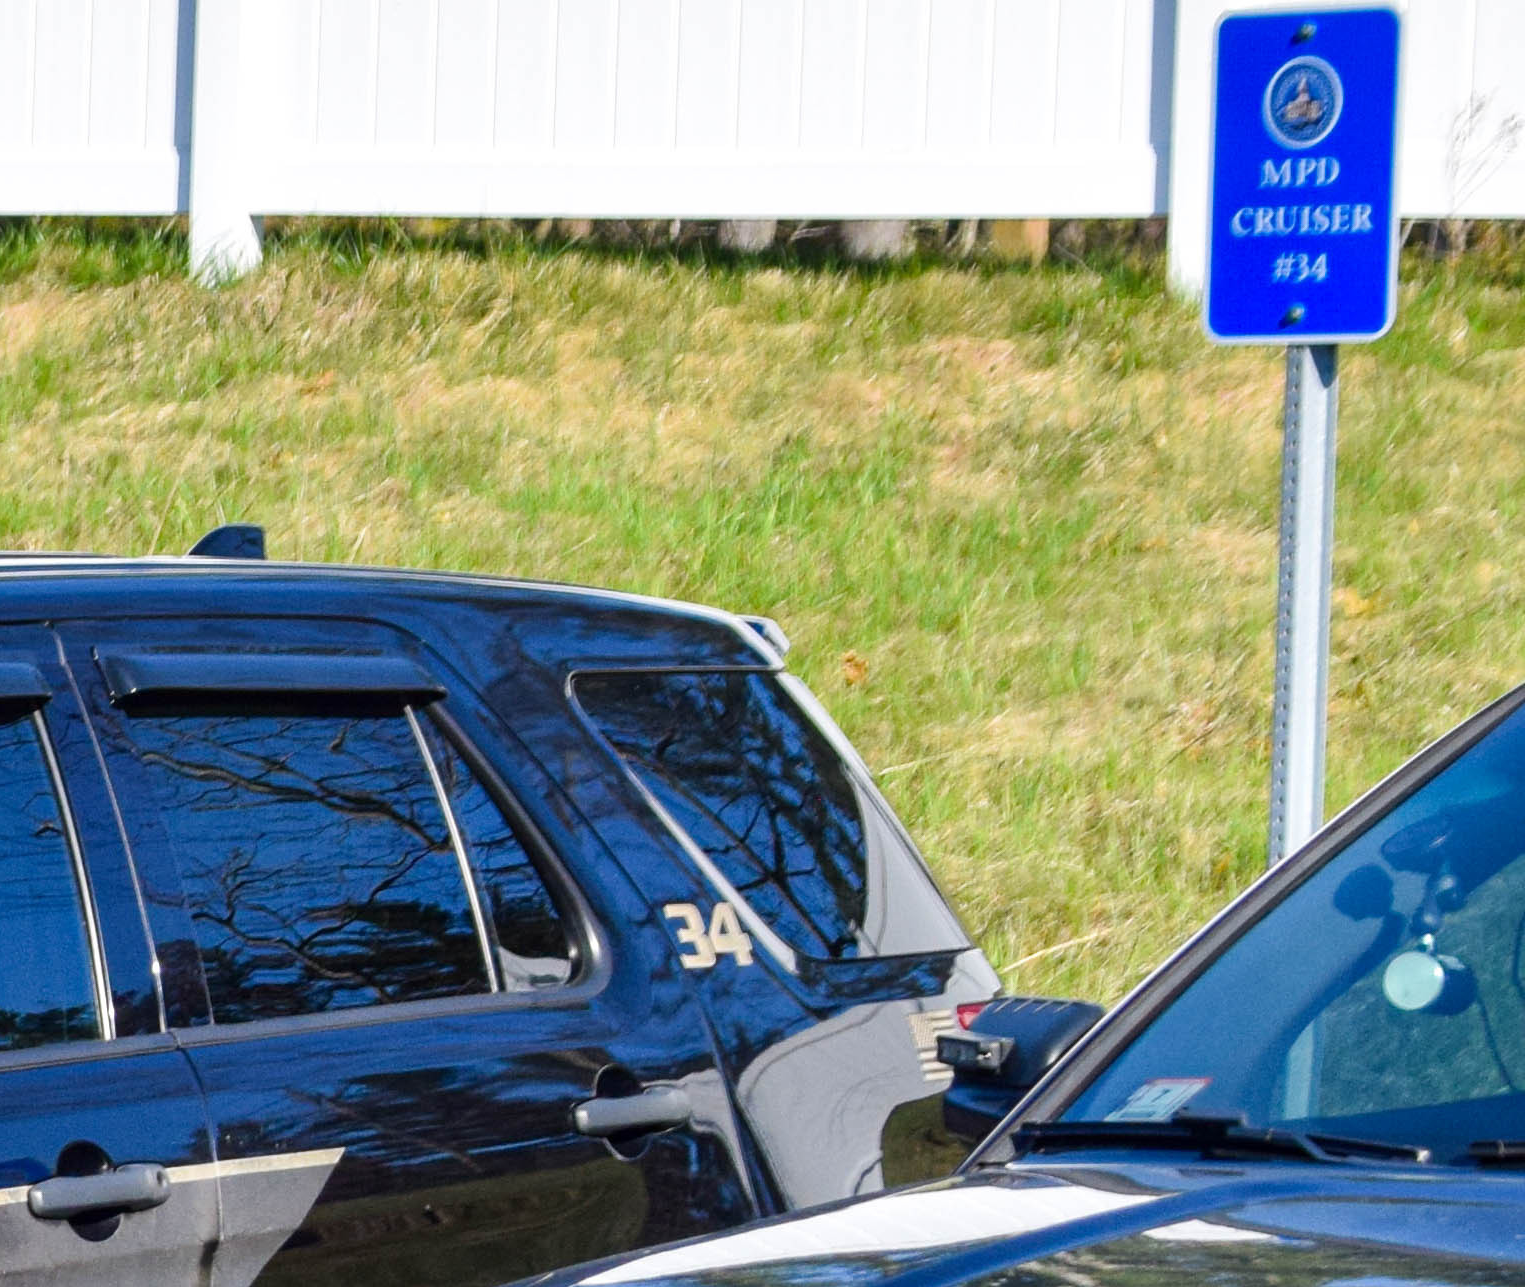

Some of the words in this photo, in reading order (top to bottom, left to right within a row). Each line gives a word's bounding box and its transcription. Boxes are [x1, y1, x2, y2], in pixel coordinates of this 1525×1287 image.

[1259, 157, 1341, 187] MPD
[1231, 204, 1373, 237] CRUISER
[1272, 252, 1329, 283] #34
[663, 901, 753, 969] 34
